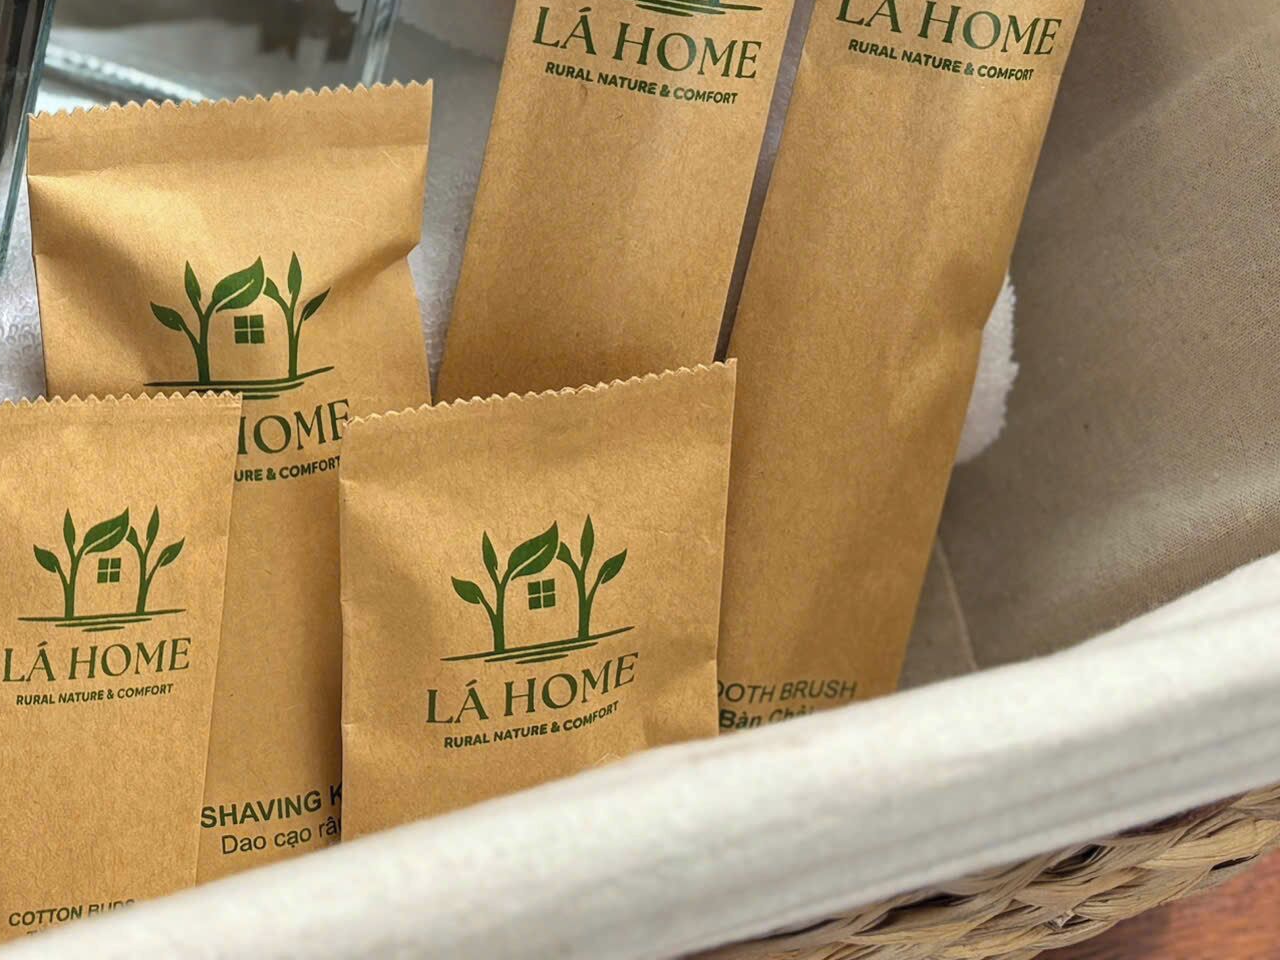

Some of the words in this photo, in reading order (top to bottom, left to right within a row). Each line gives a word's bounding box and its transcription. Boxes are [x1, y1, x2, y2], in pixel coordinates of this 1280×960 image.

[532, 6, 597, 55] LÁ
[612, 22, 762, 79] HOME
[918, 0, 1062, 56] HOME
[847, 38, 898, 60] RURAL
[901, 49, 962, 74] NATURE
[964, 62, 975, 76] &
[977, 64, 1035, 82] COMFORT
[545, 61, 594, 83] RURAL
[597, 71, 658, 96] NATURE
[659, 84, 671, 98] &
[673, 87, 739, 105] COMFORT
[234, 468, 264, 482] URE
[266, 467, 277, 481] &
[279, 455, 340, 480] COMFORT
[2, 641, 56, 682] LÁ
[68, 637, 192, 681] HOME
[16, 694, 56, 706] RURAL
[58, 689, 105, 704] NATURE
[106, 688, 115, 700] &
[117, 683, 174, 699] COMFORT
[425, 678, 489, 724] LÁ
[503, 652, 639, 717] HOME
[717, 679, 774, 704] OTH
[779, 679, 858, 702] BRUSH
[443, 733, 490, 749] RURAL
[493, 723, 548, 742] NATURE
[550, 721, 561, 734] &
[562, 700, 620, 732] COMFORT
[200, 790, 322, 829] SHAVING
[221, 834, 267, 855] Dao
[274, 827, 312, 848] cạo
[8, 905, 83, 927] COTTON
